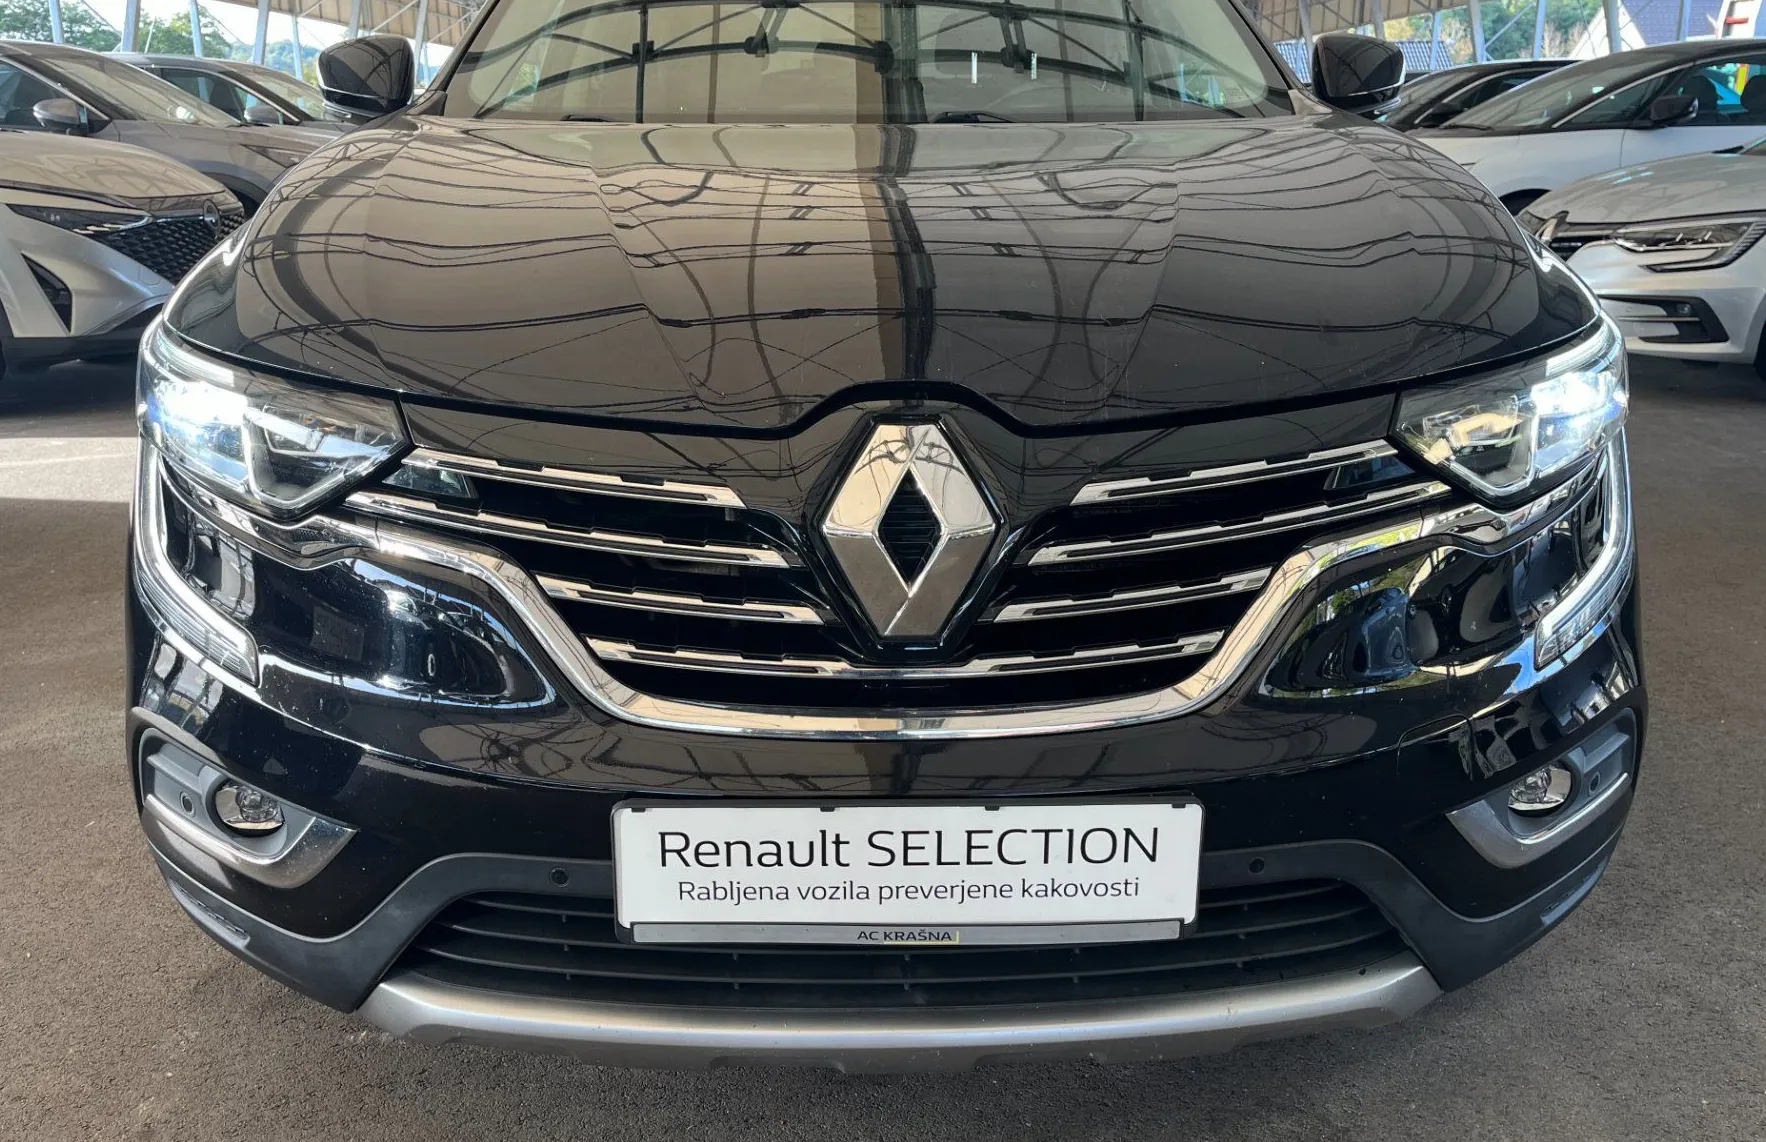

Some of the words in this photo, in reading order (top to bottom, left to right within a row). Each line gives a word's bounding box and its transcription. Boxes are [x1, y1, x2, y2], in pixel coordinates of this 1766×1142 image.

[658, 829, 850, 867] Renault
[867, 827, 1159, 866] SELECTION
[678, 880, 790, 906] Rabljena
[797, 880, 870, 901] vozila
[878, 880, 1013, 905] preverjene
[1021, 877, 1139, 899] kakovosti
[857, 930, 879, 941] AC
[883, 928, 953, 941] KRAŠNA
